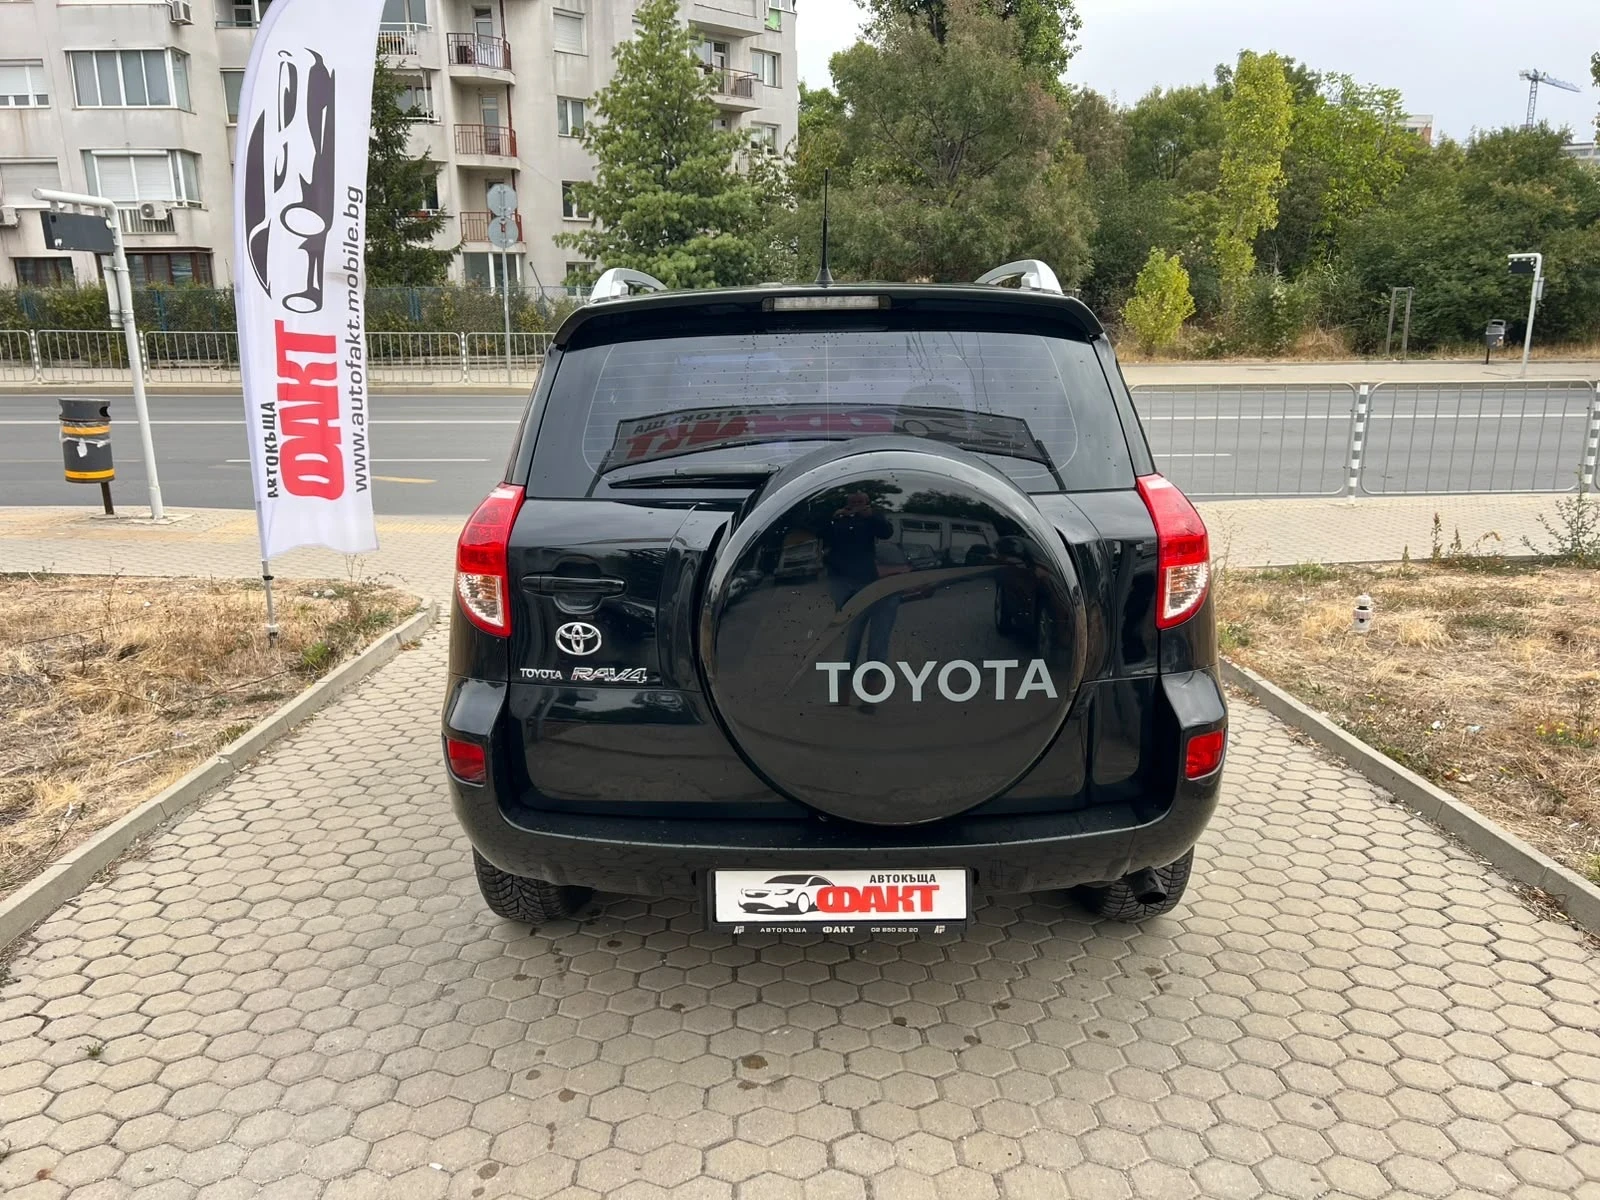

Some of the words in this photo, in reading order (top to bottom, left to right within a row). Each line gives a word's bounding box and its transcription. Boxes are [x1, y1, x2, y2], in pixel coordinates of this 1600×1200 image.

[343, 185, 368, 493] www.autofakt.mobile.bg
[274, 319, 345, 501] ФАКТ
[260, 401, 279, 498] АВТОКЪЩА
[520, 668, 563, 680] TOYOTA
[571, 667, 648, 684] RAV4
[815, 658, 1059, 704] TOYOTA
[869, 873, 937, 885] АВТОКЪЩА
[815, 885, 939, 913] ФАКТ
[822, 925, 856, 934] ФАКТ
